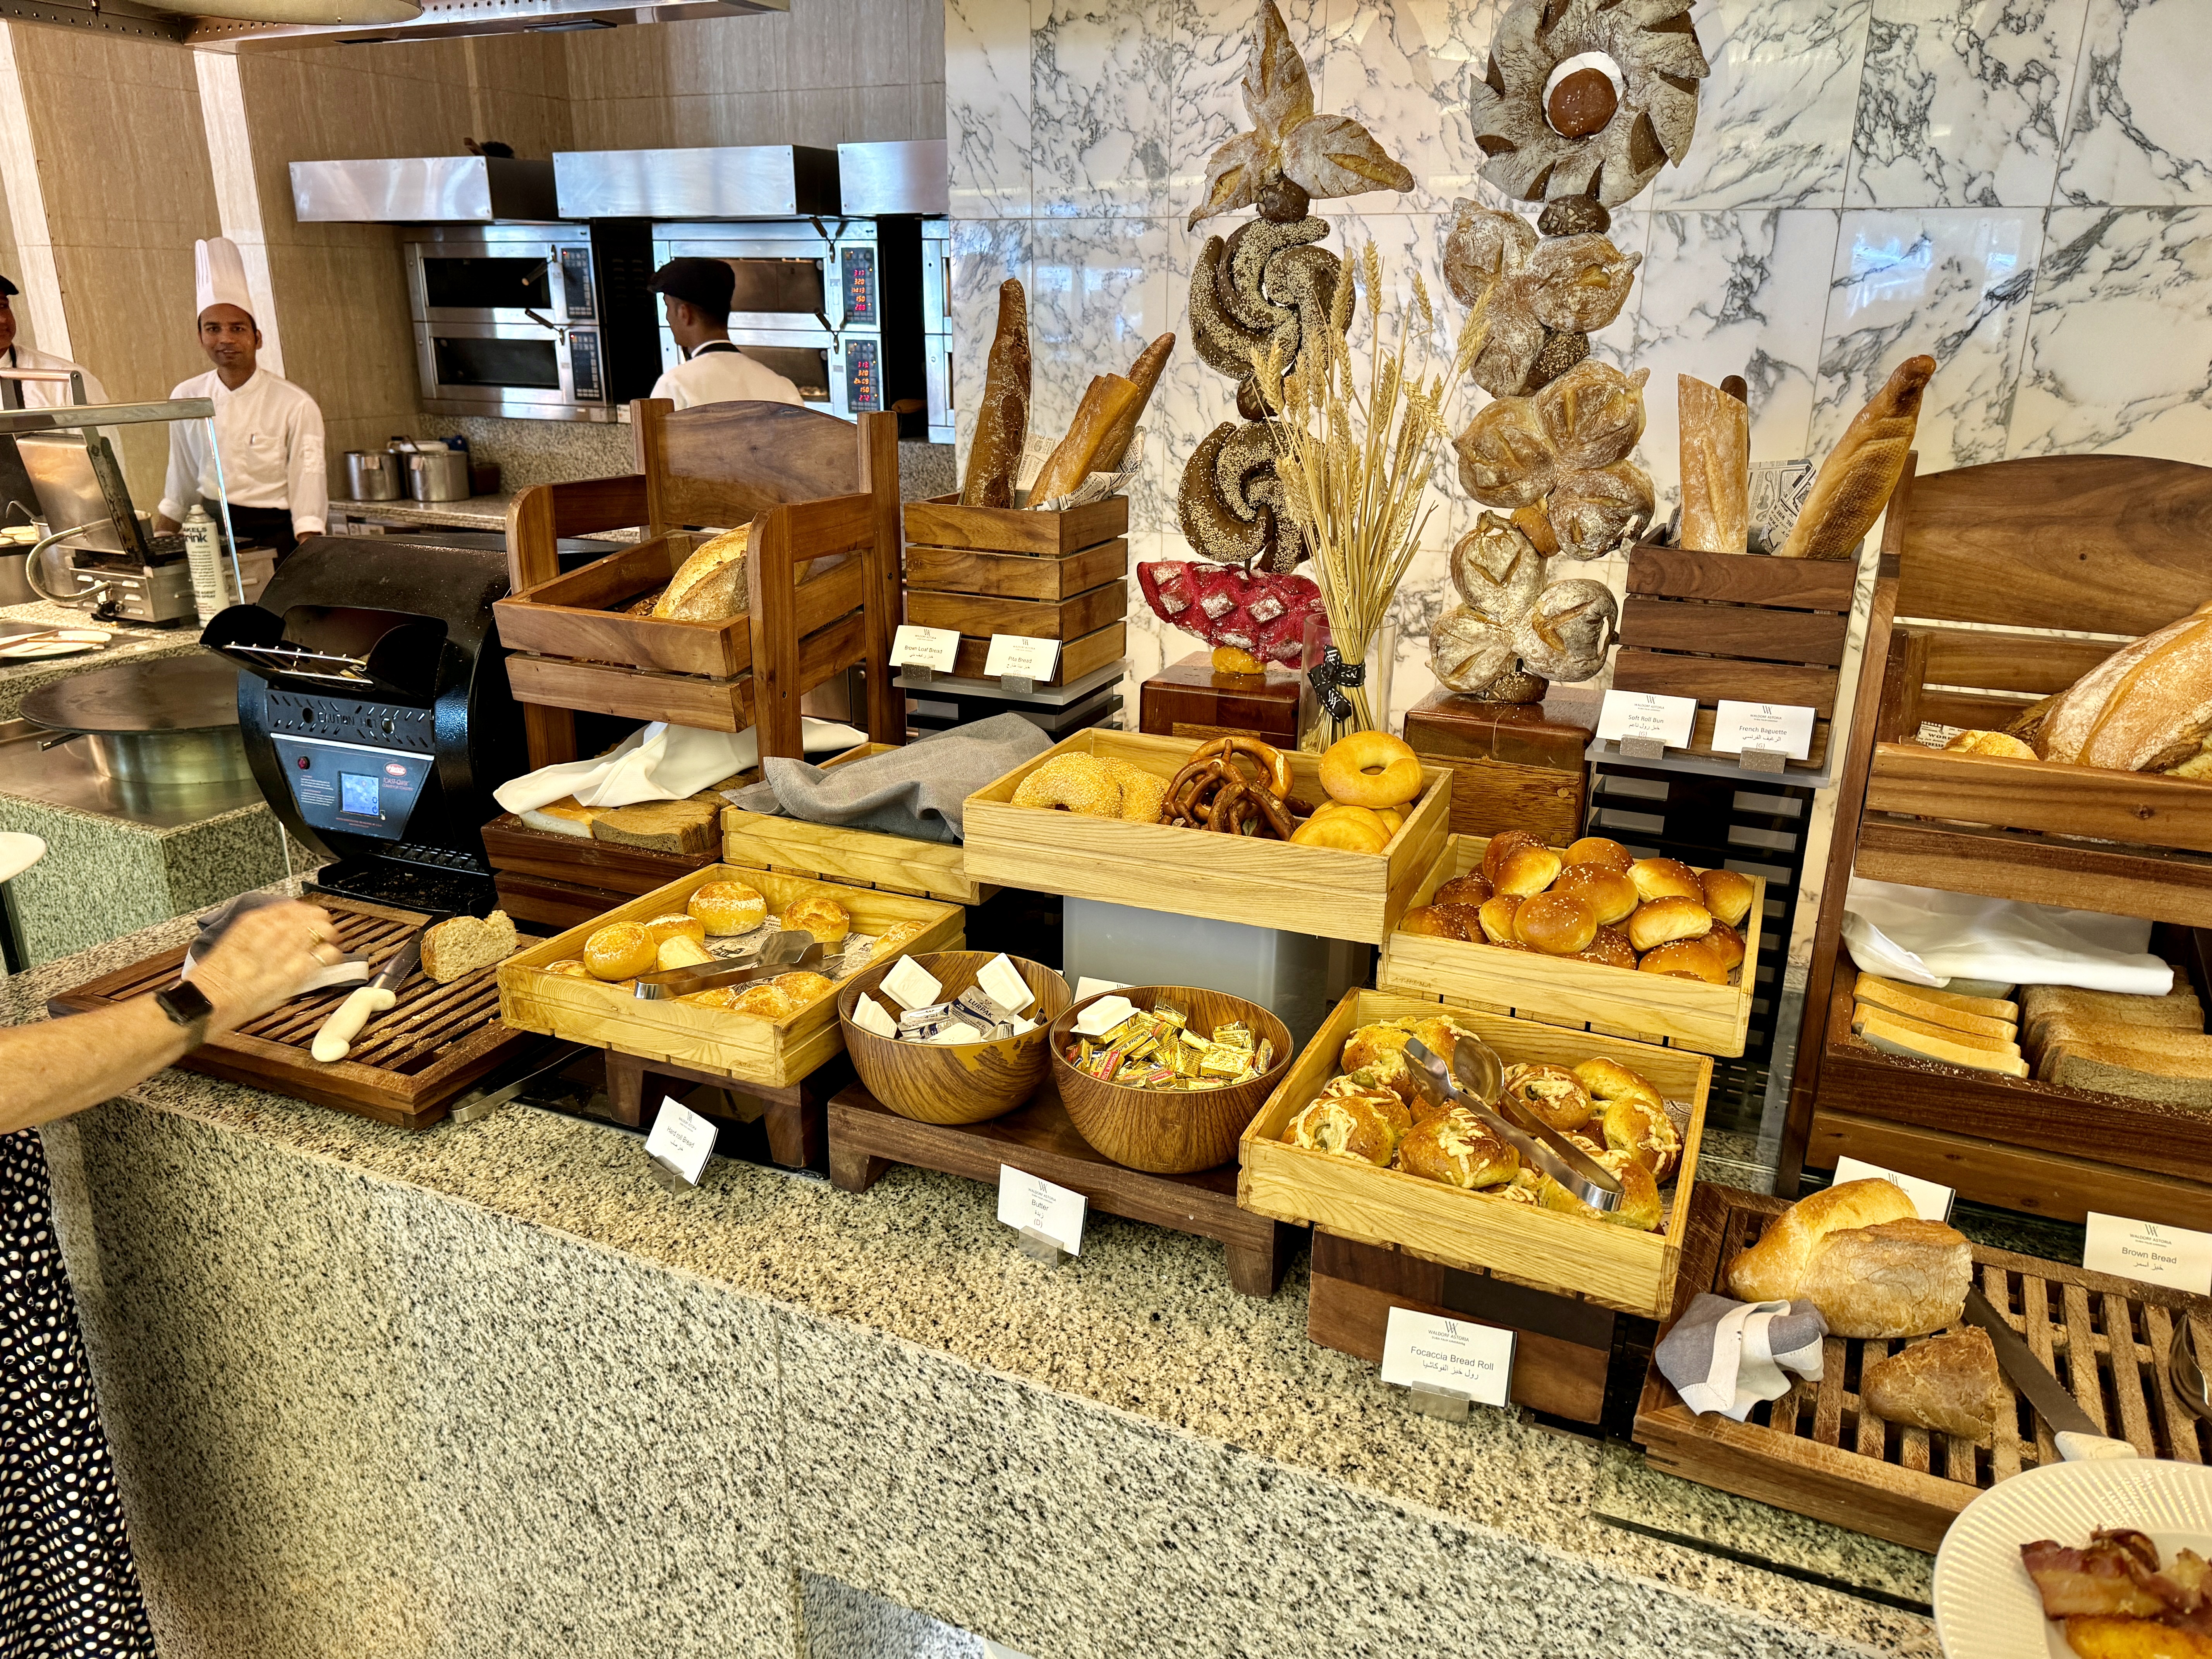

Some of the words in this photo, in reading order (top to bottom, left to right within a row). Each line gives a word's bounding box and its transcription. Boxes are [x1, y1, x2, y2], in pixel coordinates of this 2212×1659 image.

[318, 712, 355, 726] CAUTION
[361, 718, 377, 728] HOT
[968, 998, 993, 1018] LURPAK
[1128, 1031, 1147, 1046] Unsalted
[1107, 1053, 1118, 1070] Beurre
[667, 1126, 676, 1136] Hard
[683, 1136, 694, 1148] Bread
[1032, 1199, 1049, 1211] Butter
[1034, 1218, 1042, 1228] (D)
[2122, 1247, 2148, 1258] Brown
[2151, 1253, 2176, 1264] Bread
[1428, 1329, 1449, 1338] WALDORF
[1411, 1346, 1447, 1360] Focaccia
[1450, 1355, 1475, 1367] Bread
[1478, 1360, 1494, 1371] Roll
[1465, 1369, 1479, 1380] رول
